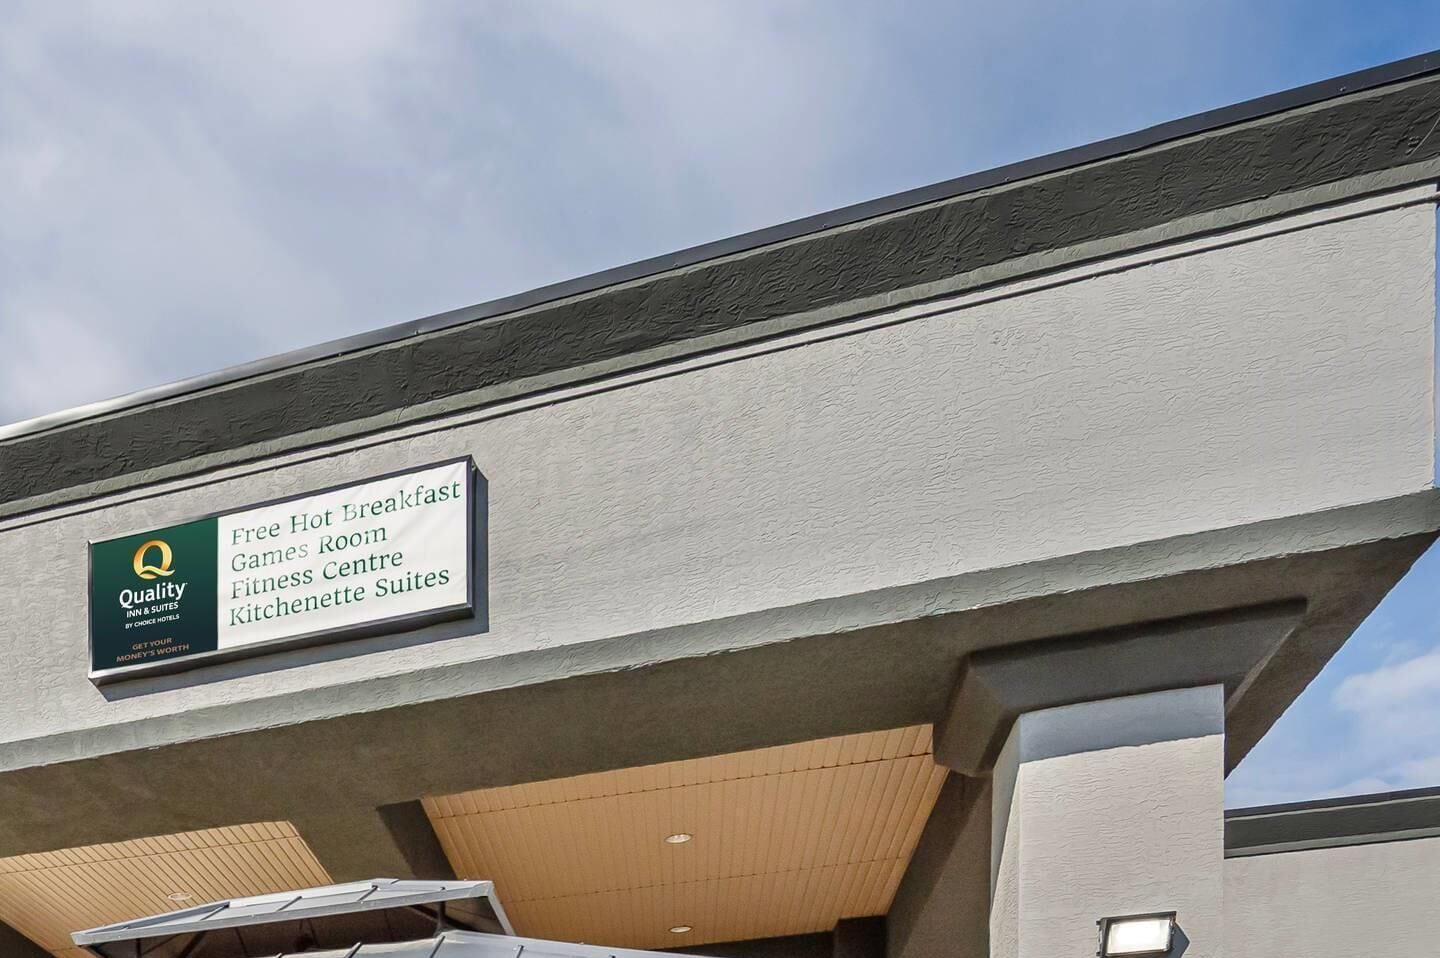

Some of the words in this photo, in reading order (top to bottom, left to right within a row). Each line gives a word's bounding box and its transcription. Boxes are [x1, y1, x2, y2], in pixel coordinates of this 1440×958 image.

[231, 523, 280, 545] Free
[290, 510, 333, 534] Hot
[342, 480, 461, 522] Breakfast
[231, 543, 309, 572] Games
[318, 527, 387, 554] Room
[231, 568, 313, 599] Fitness
[323, 551, 403, 580] Centre
[119, 581, 185, 609] Quality
[229, 585, 365, 627] Kitchenette
[375, 568, 450, 597] Suites
[126, 608, 142, 618] INN
[143, 607, 150, 615] &
[151, 601, 179, 613] SUITES
[134, 618, 156, 628] CHOICE
[157, 613, 180, 623] HOTELS
[132, 641, 149, 650] GET
[150, 637, 173, 647] YOUR
[156, 643, 190, 655] WORTH
